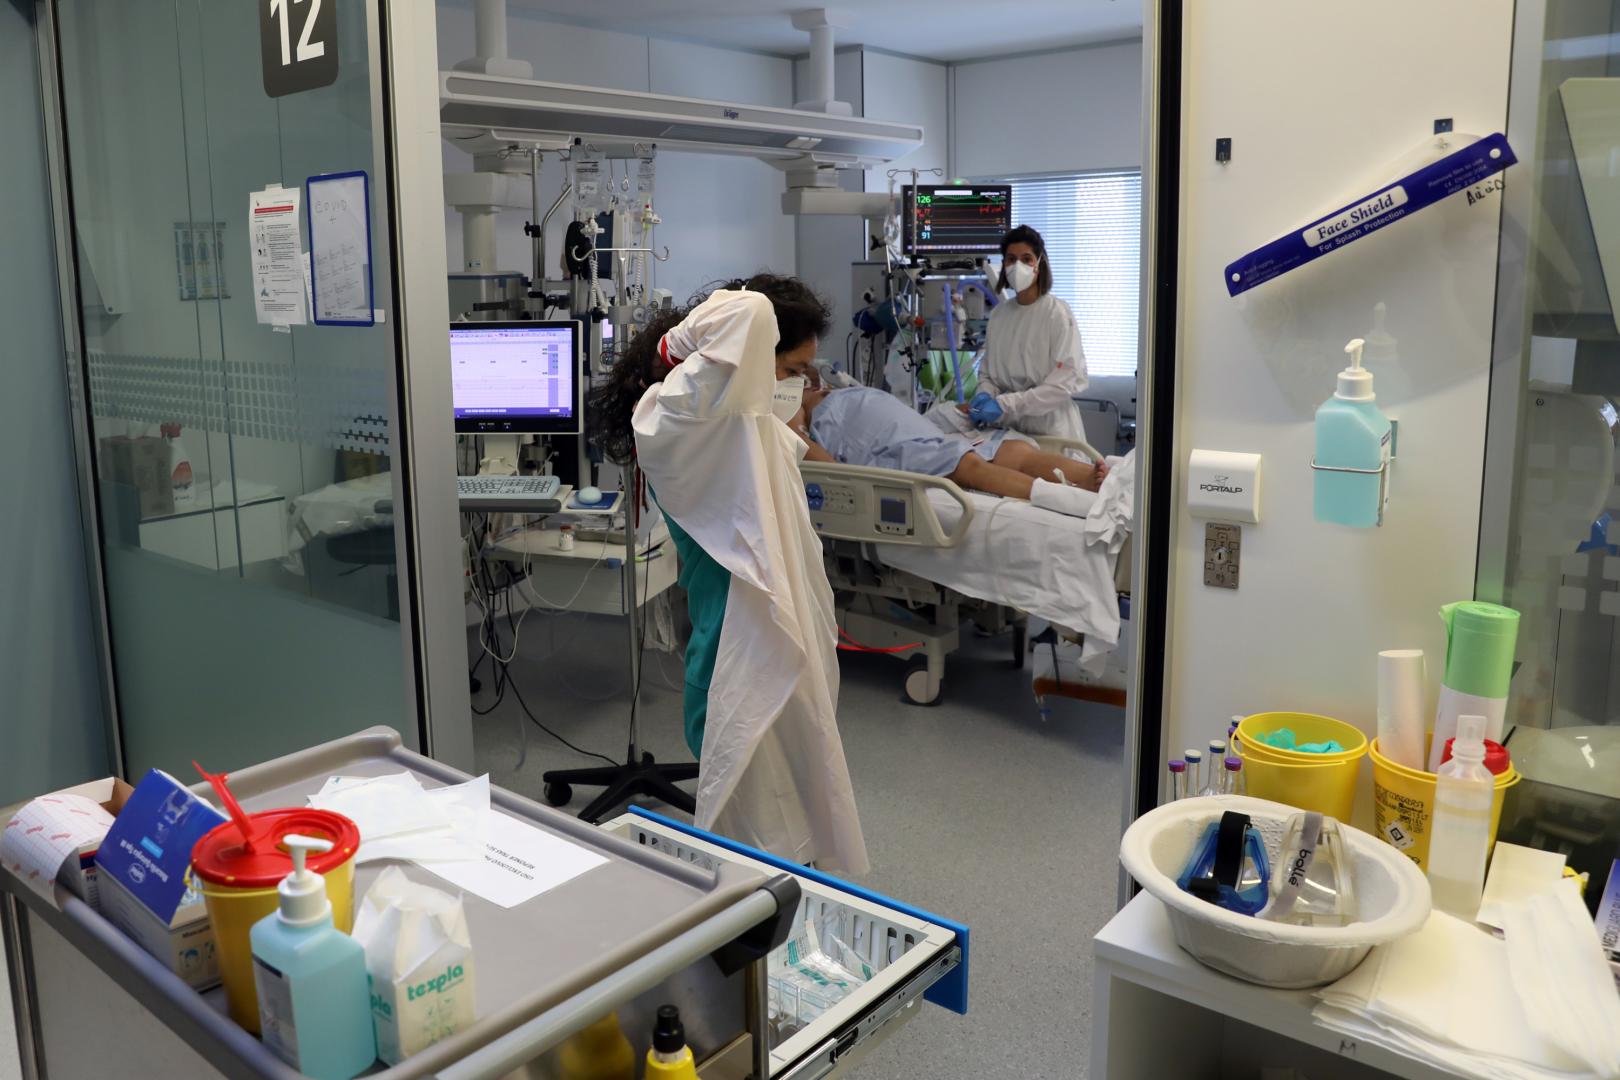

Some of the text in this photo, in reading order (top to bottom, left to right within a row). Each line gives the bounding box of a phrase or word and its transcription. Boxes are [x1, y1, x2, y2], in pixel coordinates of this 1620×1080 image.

[270, 0, 325, 66] 12
[315, 200, 347, 213] COVID
[917, 195, 931, 204] 126
[1317, 194, 1394, 240] Face Shield
[1319, 209, 1405, 253] For Splash Protection
[1200, 484, 1243, 493] PORTALP
[407, 964, 464, 1001] texpla
